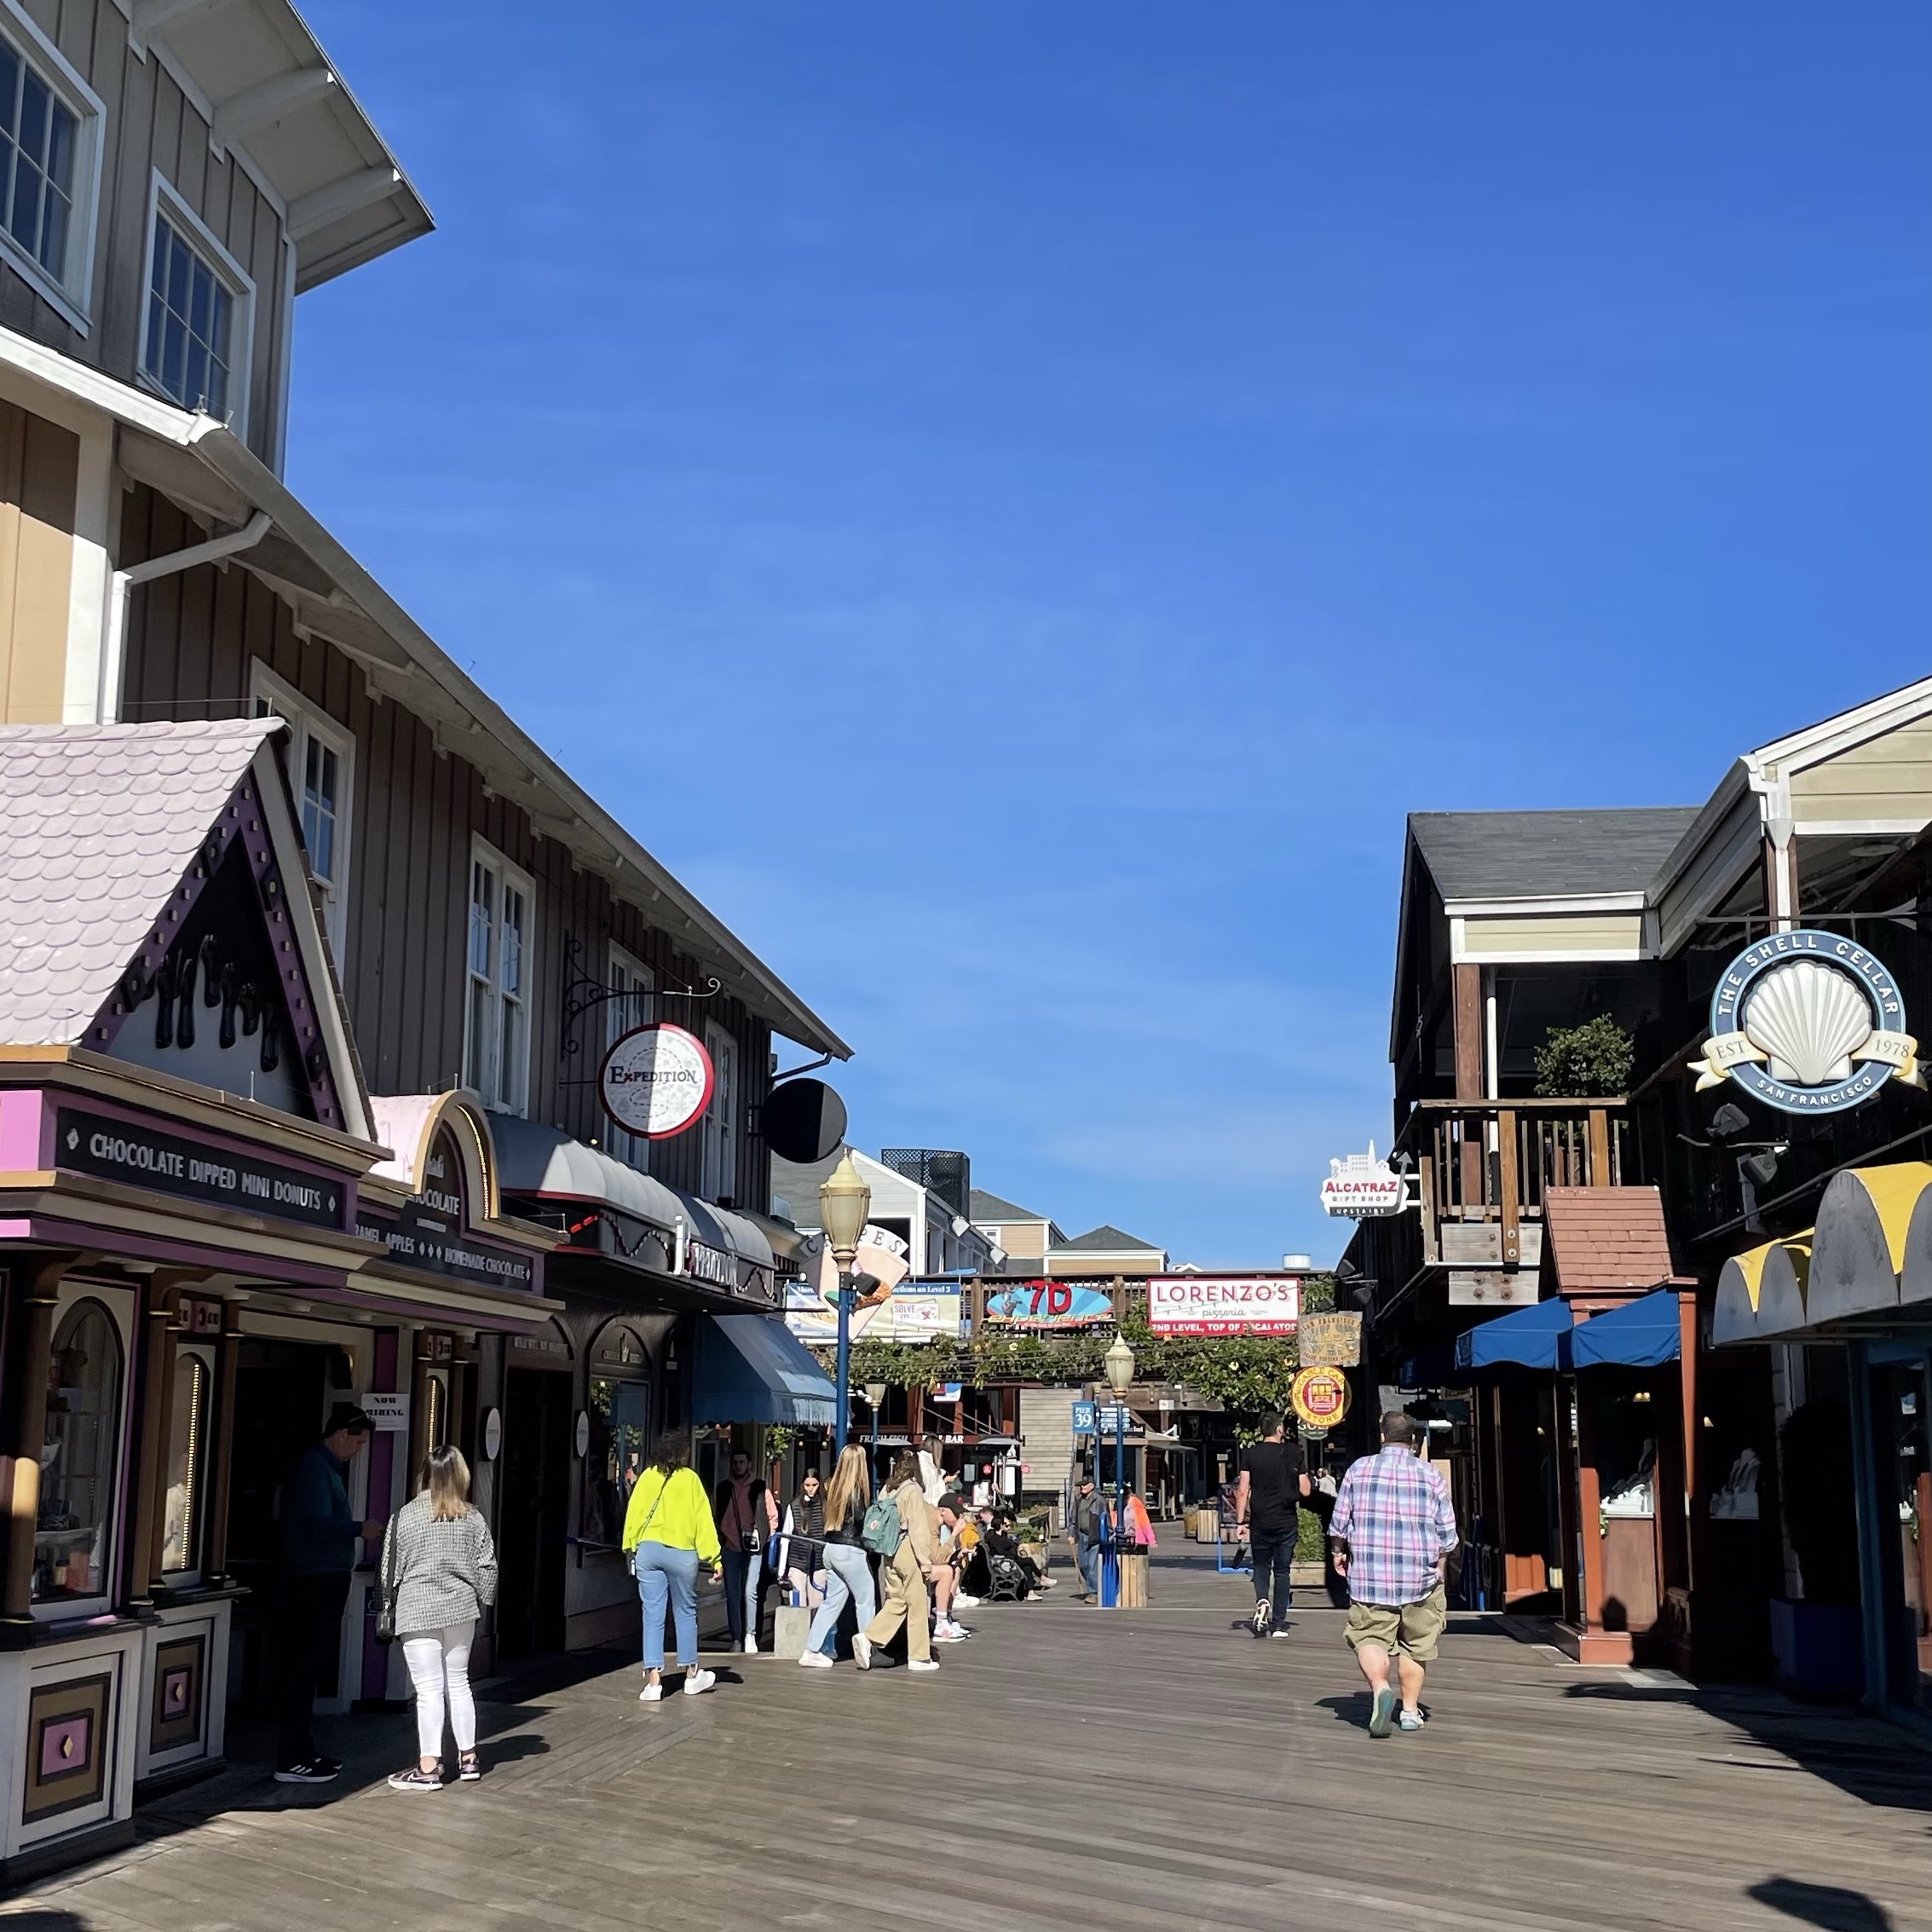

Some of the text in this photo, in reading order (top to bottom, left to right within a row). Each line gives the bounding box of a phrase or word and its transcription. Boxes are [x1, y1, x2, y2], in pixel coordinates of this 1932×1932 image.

[1718, 935, 1899, 1016] THE SHELL CELLAR
[1716, 1039, 1910, 1059] EST. 1978
[1756, 1076, 1872, 1105] SAN FRANCISCO
[89, 1133, 322, 1210] CHOCOLATE DIPPED MINI DONUTS
[1325, 1181, 1398, 1193] ALCATRAZ
[385, 1232, 415, 1254] APPLES
[444, 1248, 526, 1280] HOMEMADE CHOCOLATE
[1024, 1280, 1072, 1315] 7D
[1156, 1283, 1290, 1302] LORENZO'S
[894, 1304, 916, 1313] SOLVE
[1202, 1307, 1246, 1318] pizzeria
[1173, 1323, 1204, 1332] LEVEL,
[1207, 1323, 1225, 1331] TOP
[1227, 1323, 1241, 1331] OF
[1075, 1414, 1093, 1427] 39
[1305, 1412, 1338, 1424] STORE
[945, 1434, 965, 1444] BAR
